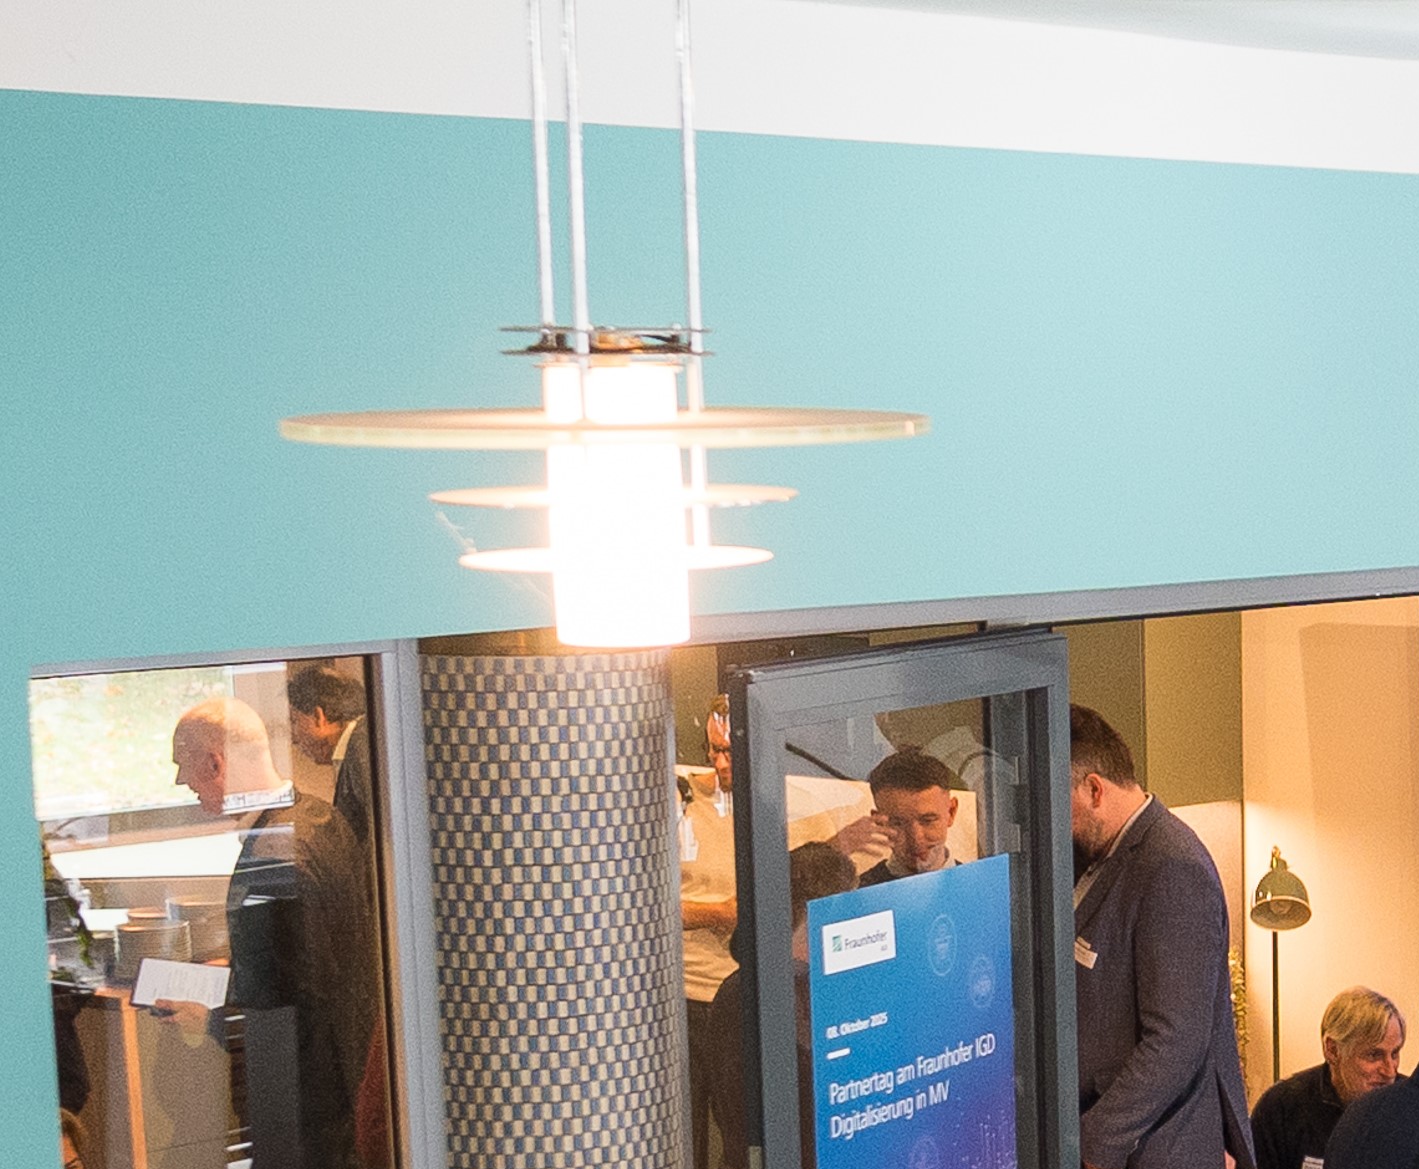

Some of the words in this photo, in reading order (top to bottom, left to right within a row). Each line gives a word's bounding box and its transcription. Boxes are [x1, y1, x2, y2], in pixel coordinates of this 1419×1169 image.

[844, 929, 888, 950] Fraunhofer
[839, 1019, 870, 1036] Oktober
[829, 1071, 894, 1105] Partnertag
[896, 1064, 915, 1085] am
[916, 1041, 973, 1078] Fraunhofer
[975, 1033, 996, 1058] IGD
[830, 1096, 914, 1140] Digitalisierung
[915, 1090, 927, 1110] in
[929, 1080, 950, 1105] MV
